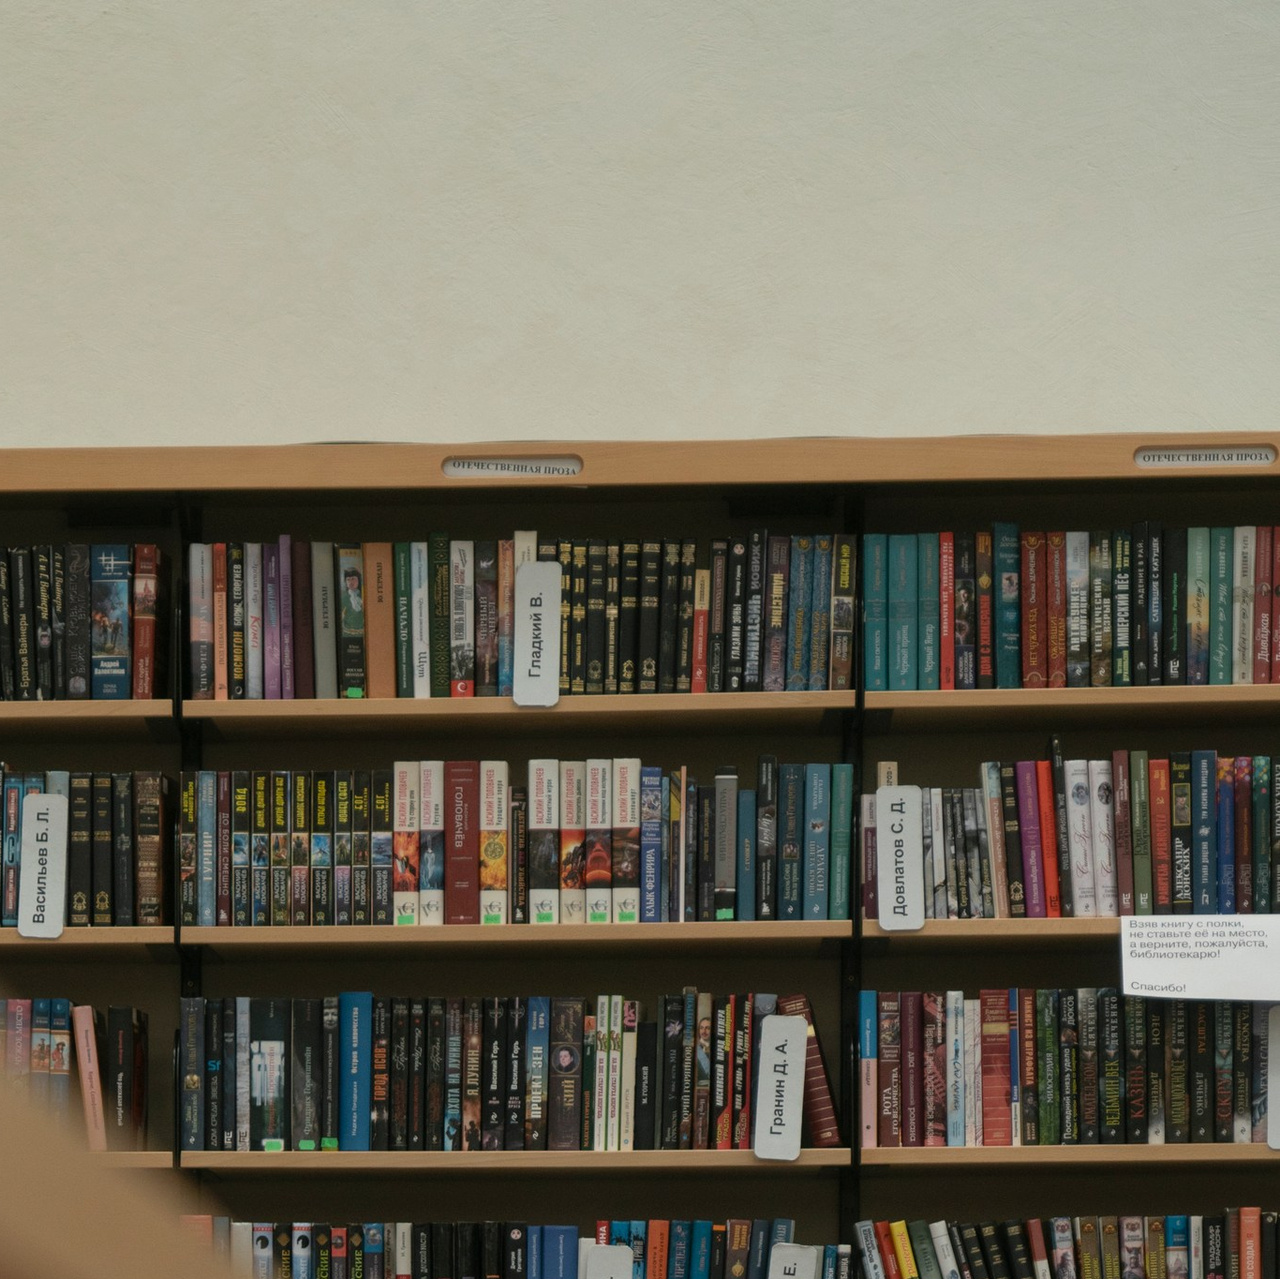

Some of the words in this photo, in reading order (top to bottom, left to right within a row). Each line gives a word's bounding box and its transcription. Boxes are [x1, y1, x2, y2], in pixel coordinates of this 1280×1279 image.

[452, 461, 542, 475] ОТЕЧЕСТВЕННАЯ
[544, 465, 576, 476] ПРОЗА
[1142, 453, 1233, 463] ОТЕЧЕСТВЕННАЯ
[1235, 453, 1270, 462] ПРОЗА
[232, 564, 242, 599] ГЕОРГИЕВ
[1115, 573, 1129, 586] ПЁС
[530, 593, 542, 607] В.
[233, 603, 242, 625] БОРИС
[399, 597, 408, 641] НАЧАЛО
[980, 595, 991, 645] ХИМЕРАМИ
[1069, 581, 1080, 651] АНТИБУНКЕР
[1080, 590, 1088, 642] НАВИГАЦИЯ
[1117, 590, 1130, 647] ИМПЕРСКИЙ
[18, 614, 28, 654] Вайнеры
[529, 613, 543, 678] Гладкий
[1258, 613, 1270, 661] Дивицкая
[232, 632, 243, 679] КОСМОГОН
[980, 654, 992, 675] ДОМ
[19, 656, 29, 687] Братья
[399, 771, 407, 800] ГОЛОВАЧЕВ
[37, 808, 50, 822] Л.
[399, 802, 408, 827] ВАСИЛИЙ
[455, 787, 463, 848] ГОЛОВАЧЁВ
[891, 798, 905, 813] Д.
[36, 827, 49, 842] Б.
[891, 818, 904, 834] С.
[646, 849, 656, 890] ФЕНРИРА
[891, 840, 907, 916] Довлатов
[1174, 838, 1184, 899] АЛЕКСАНДР
[1182, 847, 1191, 900] ДОНСКИХ
[33, 848, 47, 923] Васильев
[646, 893, 656, 917] КЛЫК
[1130, 920, 1158, 928] Взяв
[1160, 921, 1193, 930] книгу
[1207, 920, 1244, 929] полки,
[1194, 930, 1209, 938] её
[1212, 930, 1226, 938] на
[1229, 930, 1268, 939] место,
[1130, 950, 1220, 960] библиотекарю!
[1140, 941, 1191, 950] верните,
[1194, 940, 1268, 950] пожалуйста,
[1131, 981, 1186, 992] Спасибо!
[1110, 997, 1118, 1046] ДЯЧЕНКО
[374, 1047, 387, 1069] ПСОВ
[447, 1036, 460, 1069] ЛУНИНА
[491, 1041, 499, 1058] Горъ
[531, 1046, 543, 1068] ЗЕН
[775, 1039, 788, 1054] А.
[467, 1050, 480, 1085] ЛУНИН
[775, 1059, 788, 1075] Д.
[1063, 1049, 1071, 1072] удела
[1105, 1060, 1119, 1077] ВЕК
[375, 1074, 387, 1100] ГОРОД
[447, 1071, 460, 1083] НА
[490, 1060, 498, 1090] Василий
[448, 1087, 461, 1114] ОХОТА
[468, 1087, 480, 1095] Я,
[531, 1074, 543, 1118] ПРОЕКТ
[883, 1087, 892, 1115] РОТА
[891, 1068, 899, 1118] ВЕЛИЧЕСТВА
[1106, 1079, 1120, 1126] ВЕДЬМИН
[1130, 1065, 1144, 1118] КАЗНЬ
[770, 1080, 785, 1135] Гранин
[1063, 1098, 1072, 1139] Последний
[784, 1263, 797, 1277] Е.
